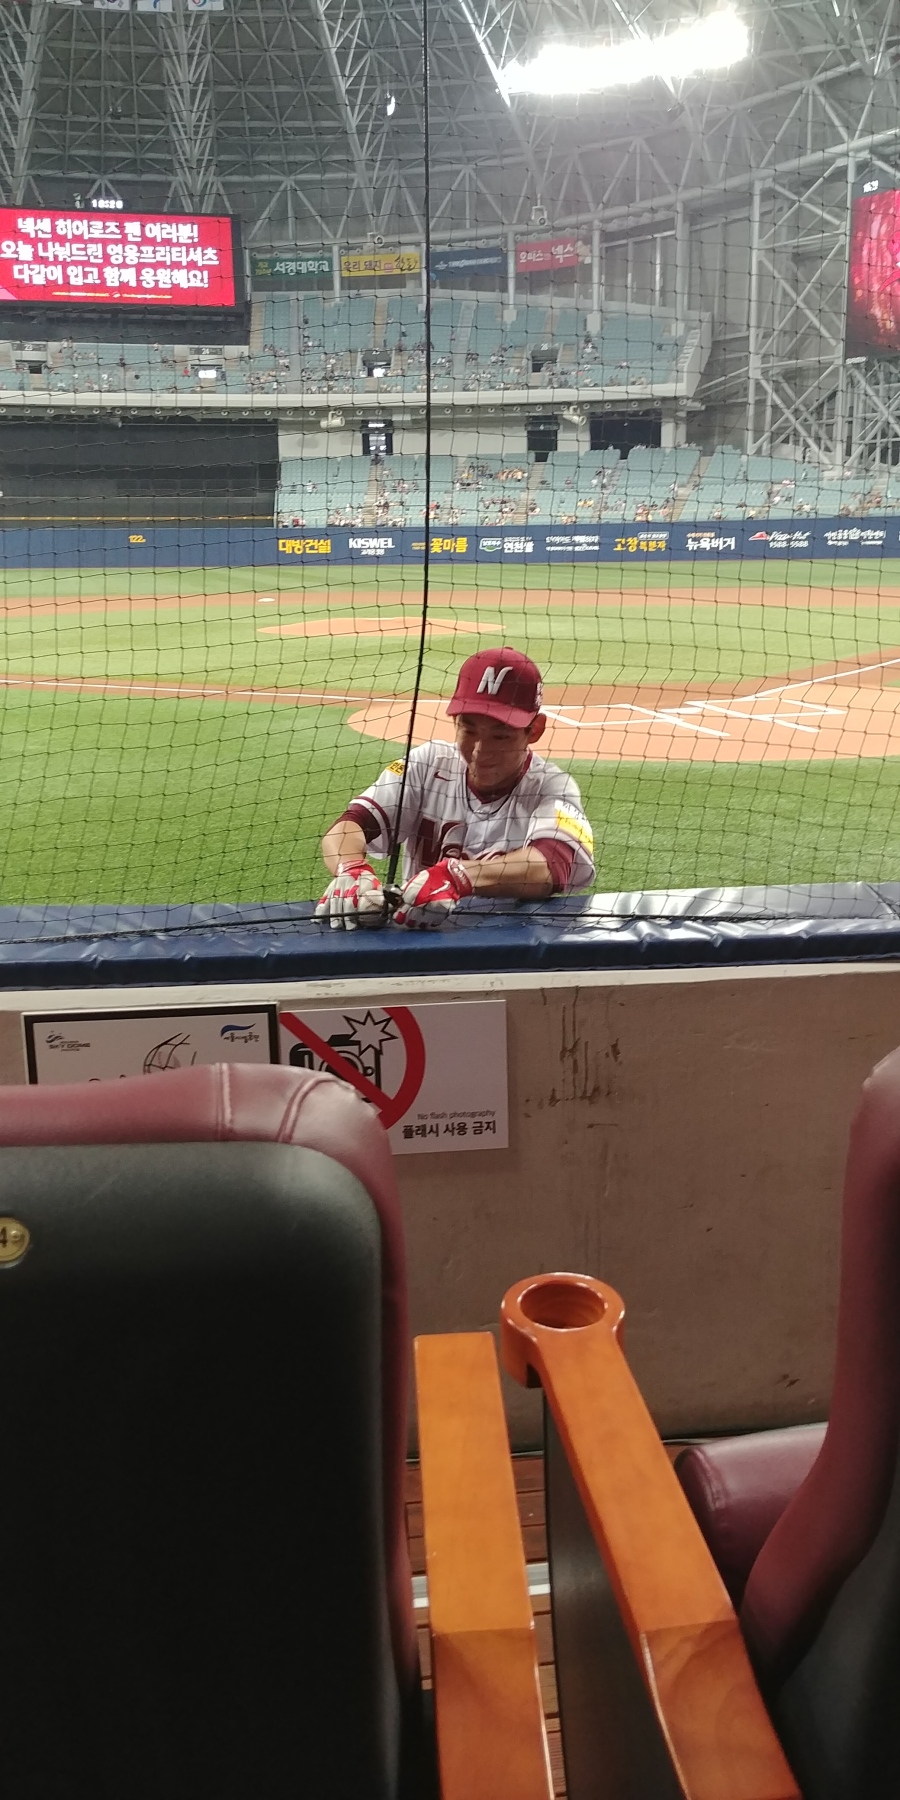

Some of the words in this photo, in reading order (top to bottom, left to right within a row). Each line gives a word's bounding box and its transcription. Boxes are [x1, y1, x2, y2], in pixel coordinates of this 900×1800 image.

[17, 217, 52, 238] 넥센
[55, 218, 122, 239] 히어로즈
[124, 221, 142, 242] 팬
[145, 222, 198, 243] 여러분!
[0, 240, 34, 261] 오늘
[37, 241, 103, 263] 나눠드린
[106, 244, 219, 266] 영웅프리티셔츠
[273, 260, 330, 275] 서경대학교
[343, 261, 361, 272] 우리
[13, 264, 63, 285] 다같이
[66, 265, 101, 286] 입고
[103, 266, 137, 287] 함께
[139, 267, 209, 289] 응원해요!
[279, 539, 331, 554] 대방건설
[348, 537, 395, 549] KISWEL
[430, 537, 468, 553] 꽃마름
[613, 537, 638, 552] 고창
[685, 536, 736, 551] 뉴욕버거
[476, 665, 514, 695] N
[429, 1111, 448, 1119] flash
[448, 1109, 496, 1119] photography
[402, 1123, 440, 1139] 플래시
[442, 1121, 469, 1137] 사용
[471, 1119, 497, 1135] 금지
